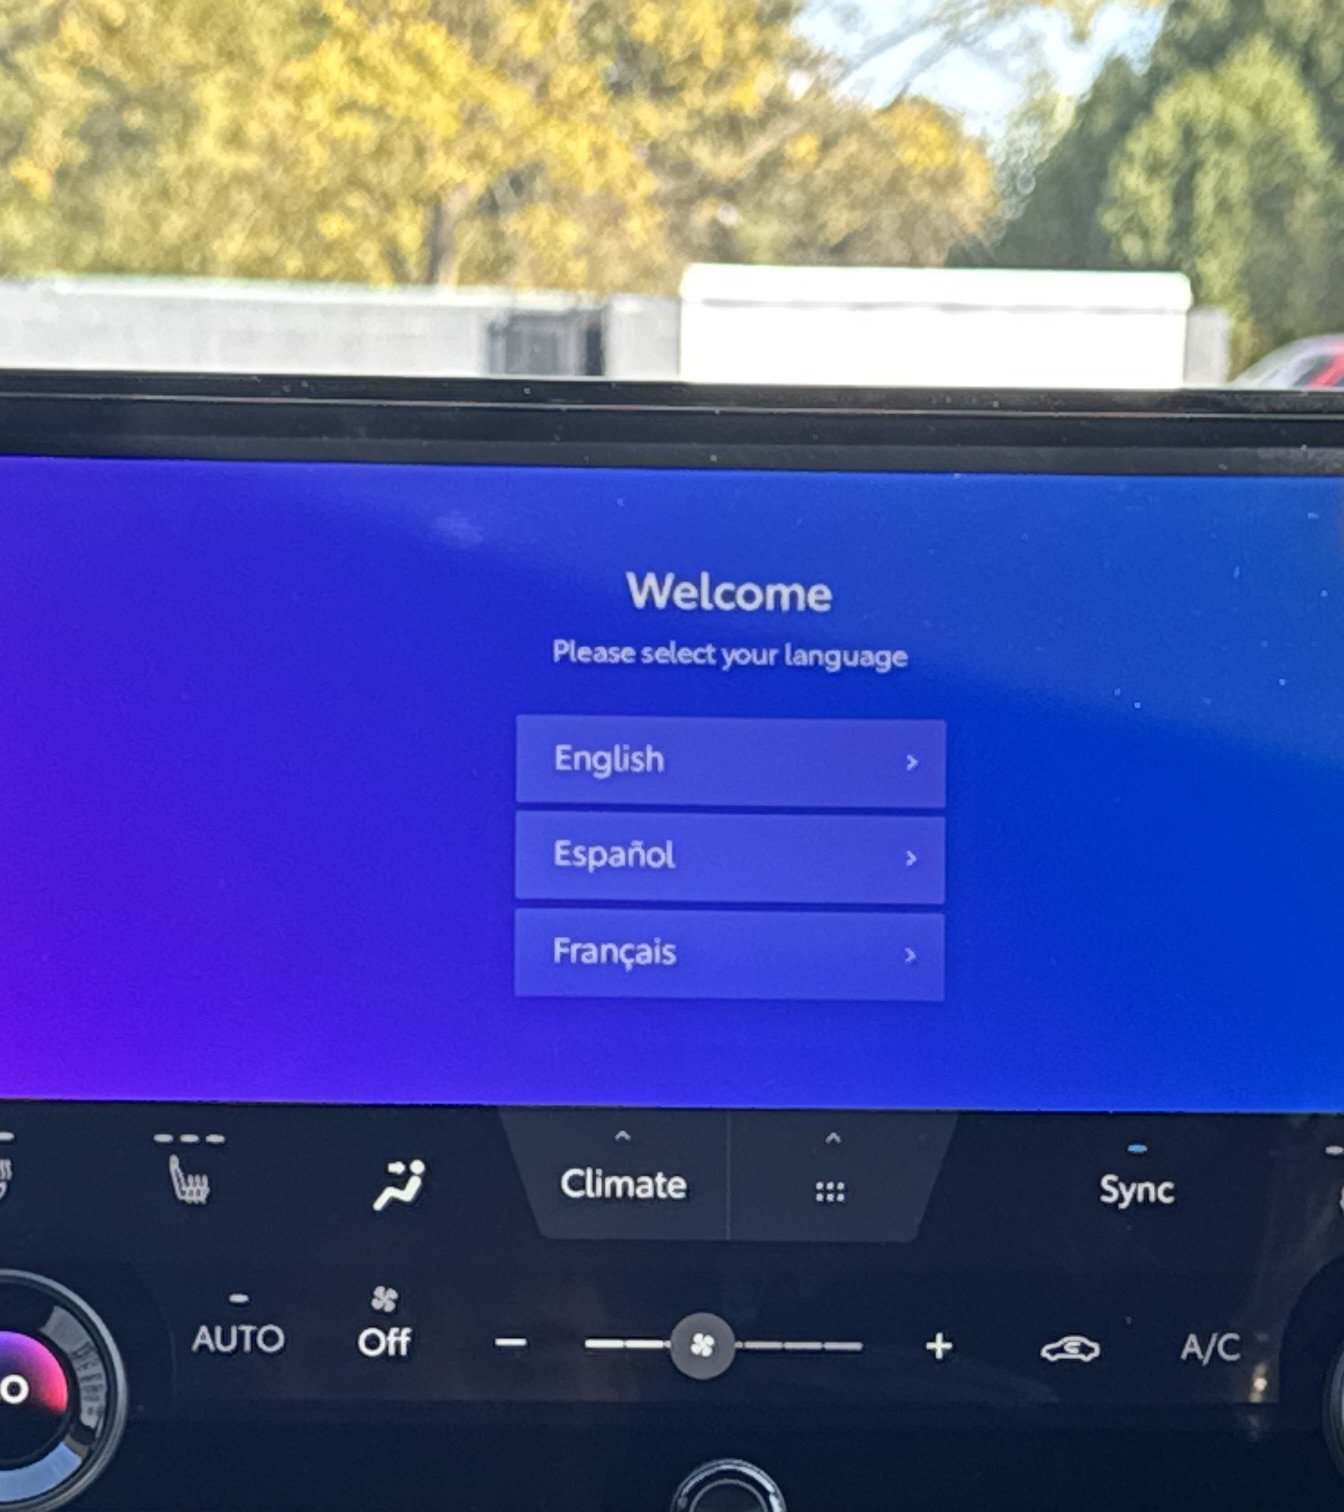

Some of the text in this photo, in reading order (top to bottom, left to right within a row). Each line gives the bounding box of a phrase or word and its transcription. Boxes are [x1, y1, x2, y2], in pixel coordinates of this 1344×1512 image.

[626, 571, 833, 612] Welcome
[553, 639, 909, 673] Please select your language
[555, 743, 665, 779] English
[554, 840, 676, 873] Español
[554, 937, 677, 971] Français
[560, 1168, 687, 1200] Climate
[1099, 1173, 1176, 1208] Sync
[191, 1323, 286, 1354] AUTO
[357, 1327, 413, 1358] Off
[1180, 1332, 1241, 1367] A/C
